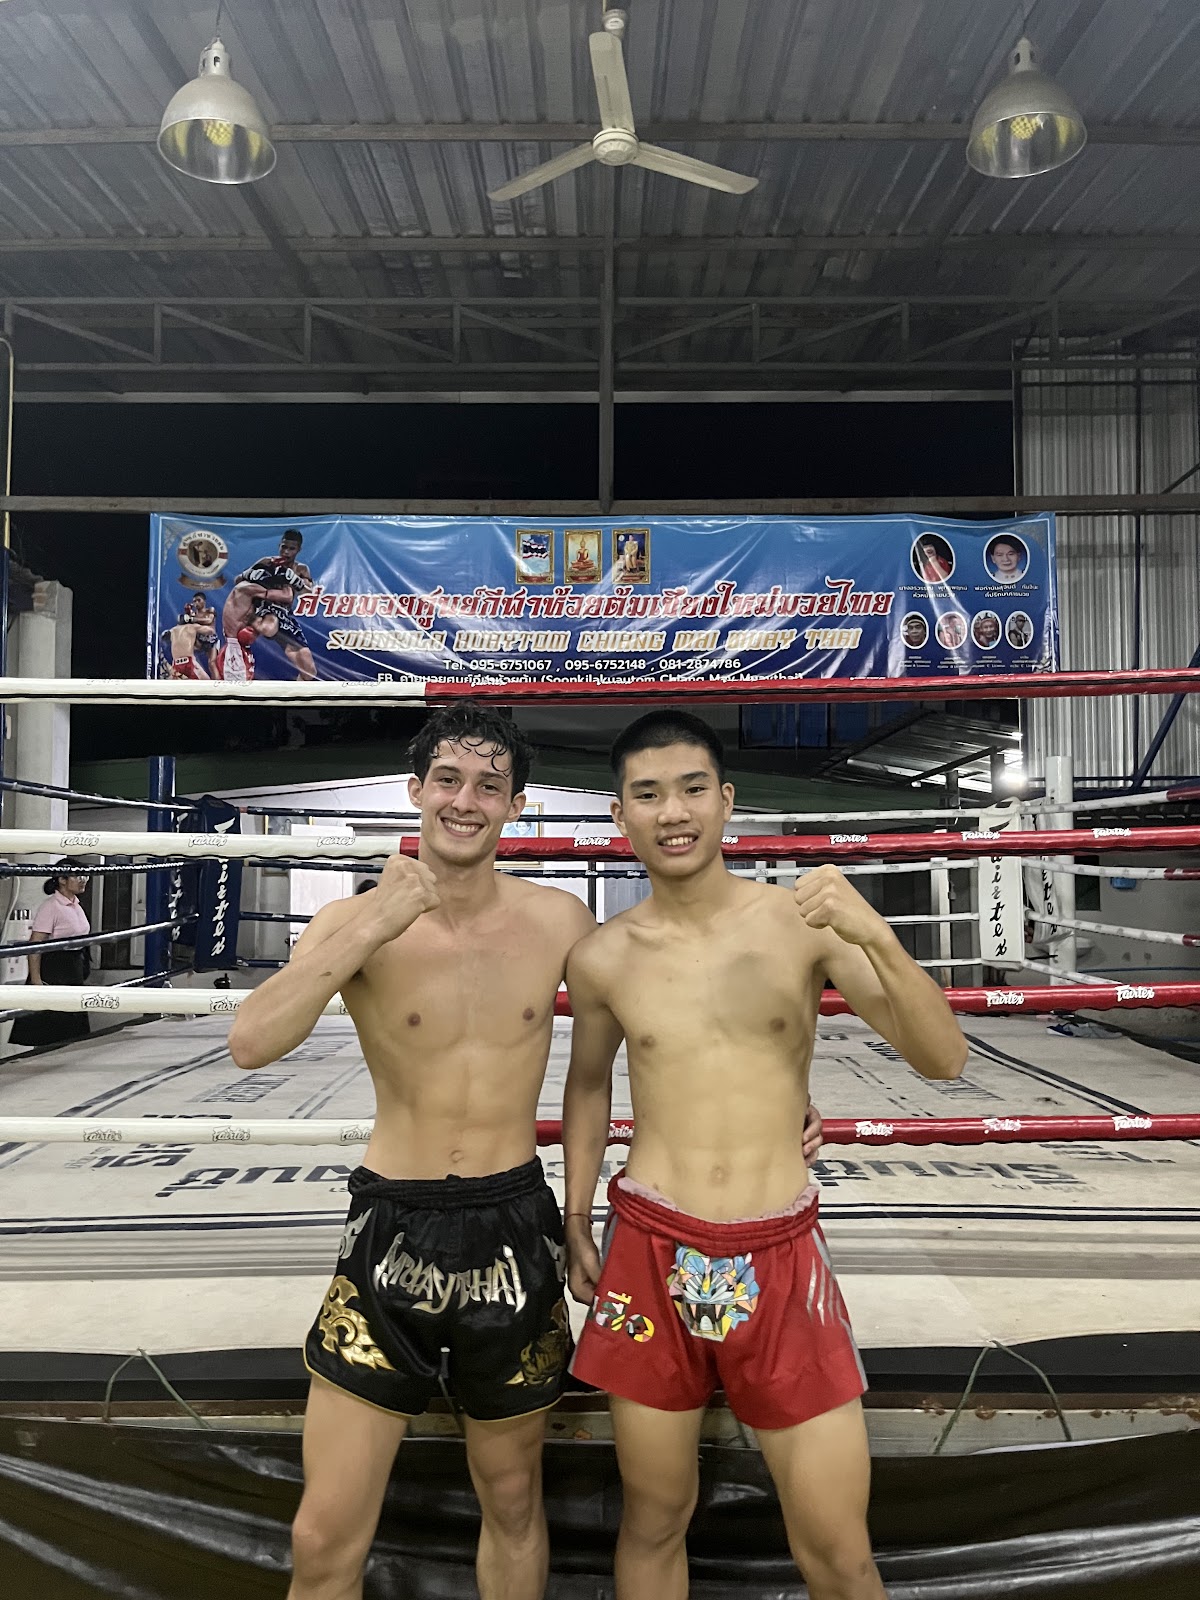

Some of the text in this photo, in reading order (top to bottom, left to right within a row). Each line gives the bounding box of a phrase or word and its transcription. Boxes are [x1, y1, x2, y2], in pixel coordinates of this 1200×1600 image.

[577, 630, 666, 652] CHIANG
[673, 629, 720, 651] MAI
[725, 629, 798, 650] MUAY
[804, 628, 863, 650] THAI
[443, 659, 466, 671] Tel.
[469, 659, 552, 671] 095-6751067
[564, 659, 646, 671] 095-6752148
[658, 658, 742, 670] 081-2874786
[574, 837, 611, 847] Fairtex
[829, 834, 869, 844] Fairtex
[961, 831, 1001, 841] Fairtex
[81, 992, 120, 1009] Fairtex
[985, 990, 1025, 1007] Fairtex
[1115, 985, 1155, 1001] Fairtex
[210, 995, 243, 1012] Fairt
[1112, 1116, 1152, 1131] Fairtex
[83, 1126, 123, 1142] Fairtex
[212, 1125, 251, 1141] Fairtex
[341, 1124, 372, 1141] Fairte
